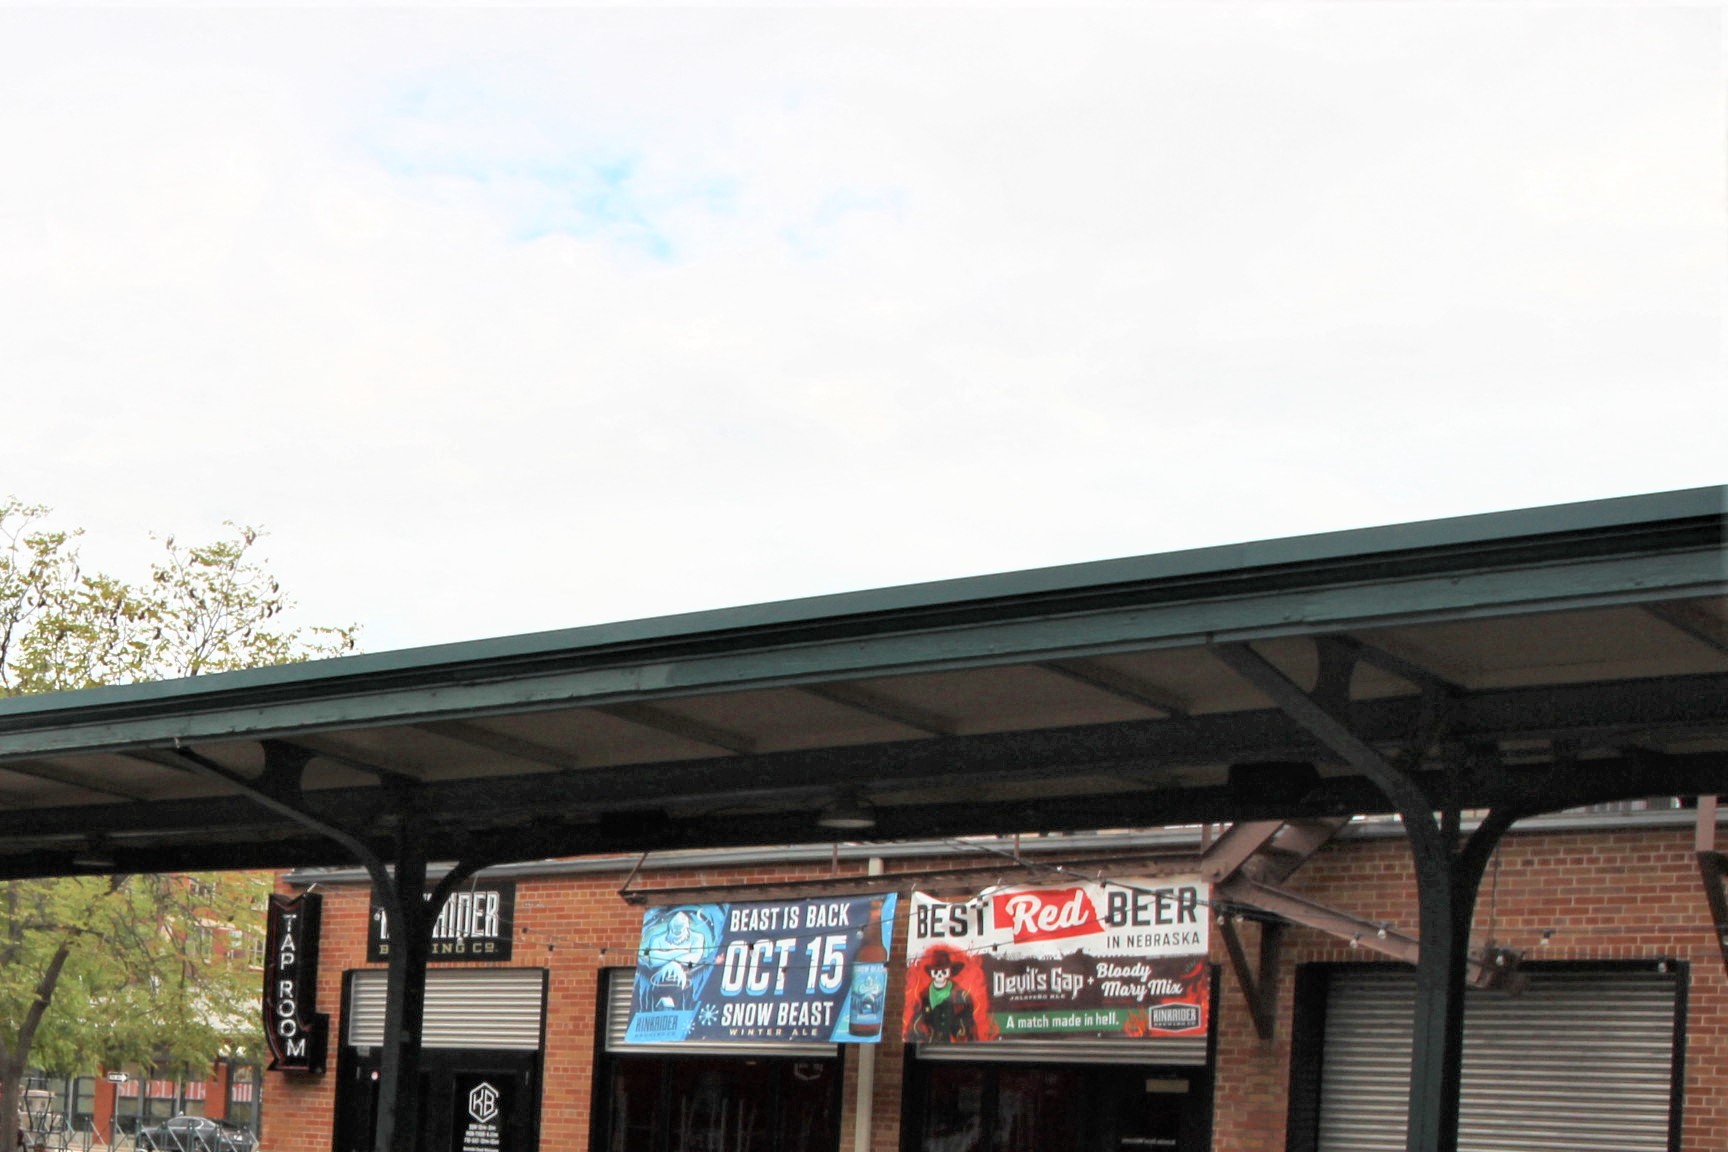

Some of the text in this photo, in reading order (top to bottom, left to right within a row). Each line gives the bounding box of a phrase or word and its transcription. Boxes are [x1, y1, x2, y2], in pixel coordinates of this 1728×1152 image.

[730, 903, 850, 932] BEAST IS BACK
[917, 886, 1197, 939] BEST Red BEER
[280, 914, 297, 970] TAP
[1107, 932, 1200, 949] IN NEBRASKA
[720, 935, 847, 997] OCT 15
[1096, 962, 1151, 982] Bloody
[993, 966, 1047, 998] Devil's
[1051, 967, 1083, 999] Gap
[1101, 979, 1183, 1001] Mary Mix
[276, 980, 306, 1057] ROOM
[722, 1001, 833, 1027] SNOW BEAST
[1006, 1012, 1119, 1029] A match made in hell.
[729, 1028, 818, 1037] WINTER ALE
